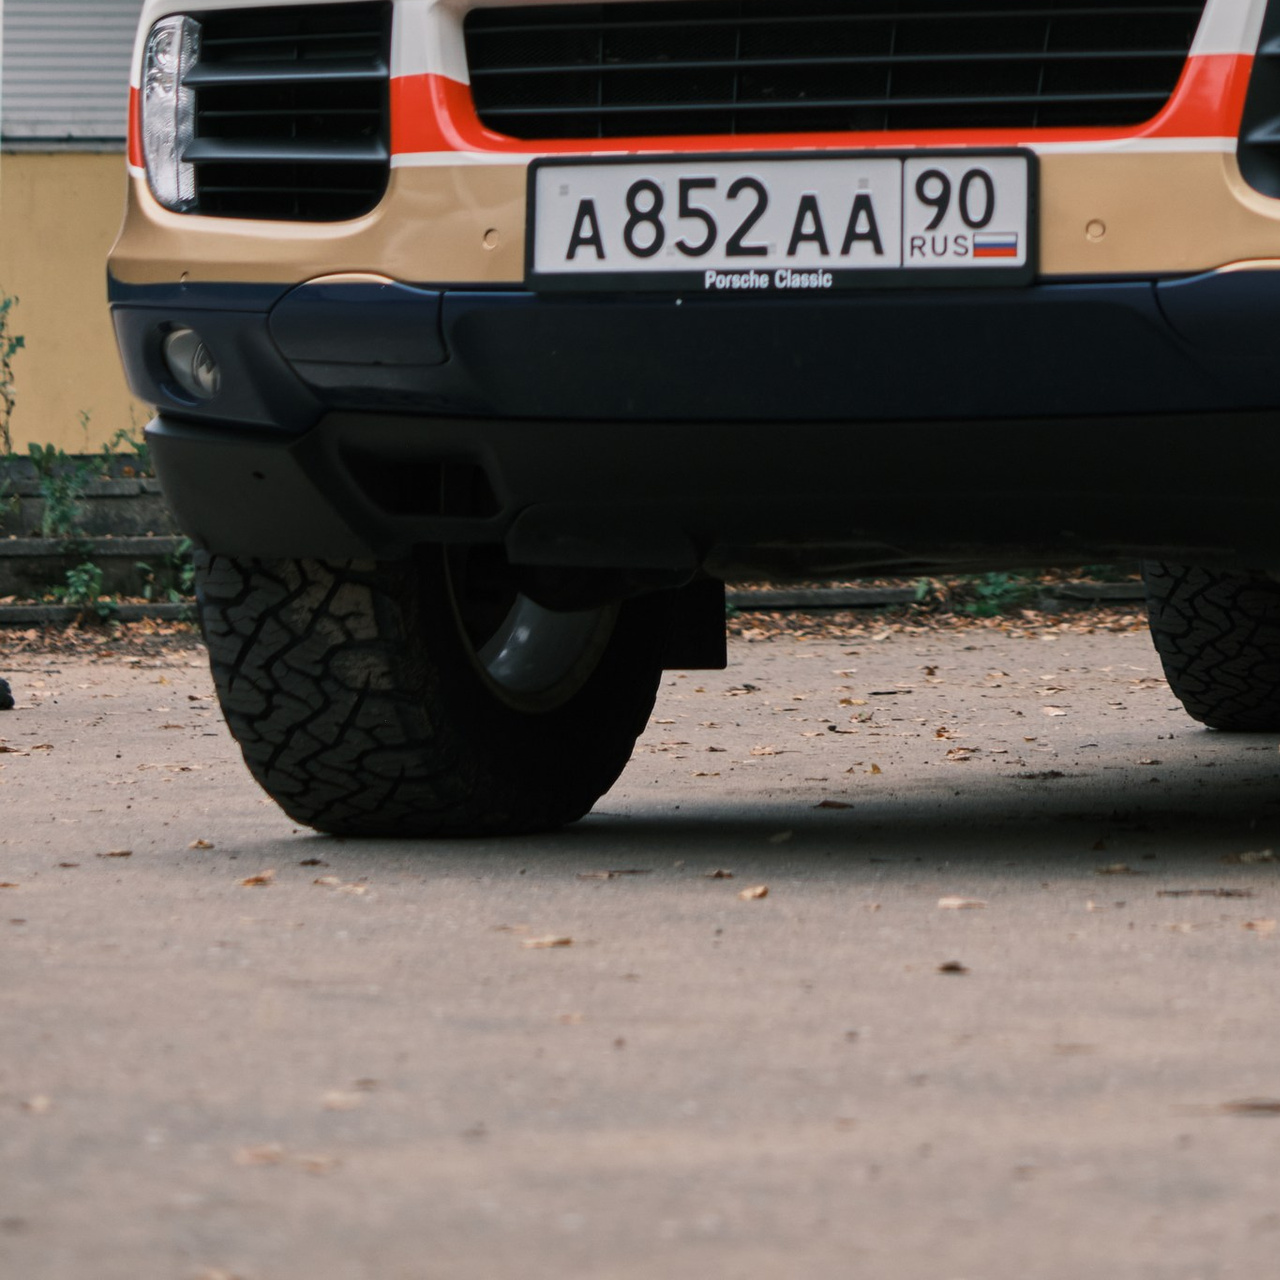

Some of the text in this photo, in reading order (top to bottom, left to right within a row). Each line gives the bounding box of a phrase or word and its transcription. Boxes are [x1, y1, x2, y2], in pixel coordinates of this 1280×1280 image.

[914, 168, 996, 230] 90
[909, 235, 969, 258] RUS
[704, 268, 833, 290] Porsche Classic
